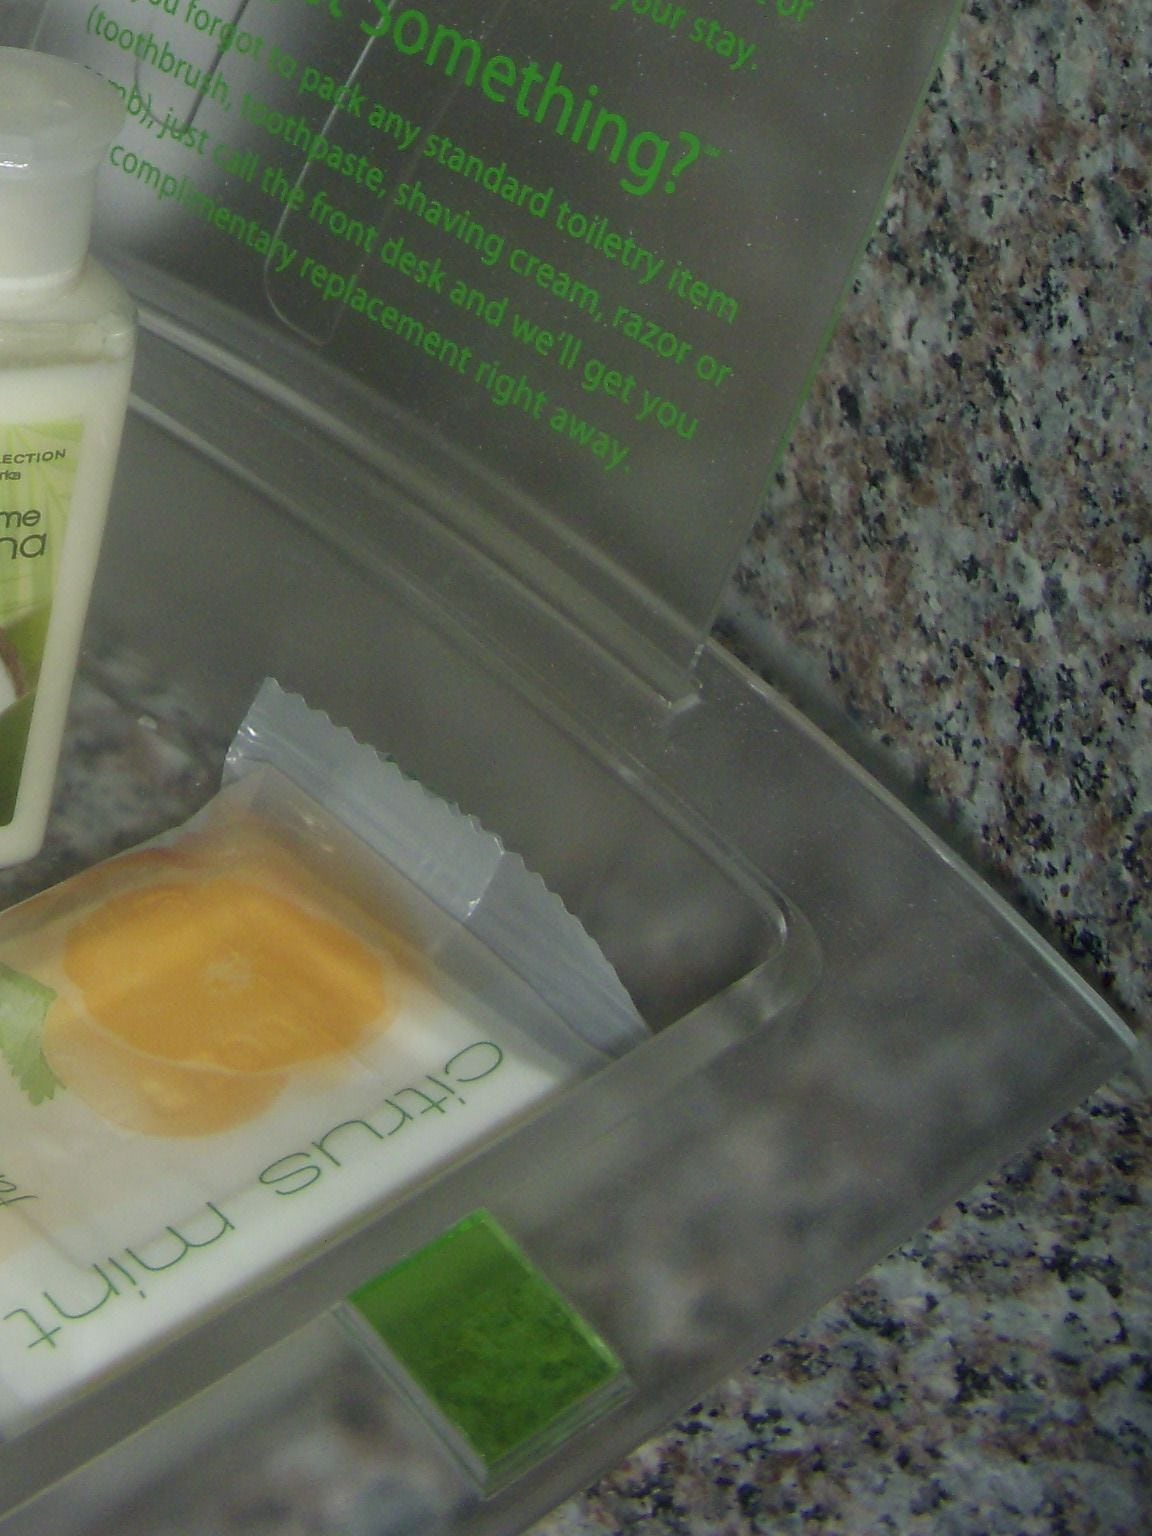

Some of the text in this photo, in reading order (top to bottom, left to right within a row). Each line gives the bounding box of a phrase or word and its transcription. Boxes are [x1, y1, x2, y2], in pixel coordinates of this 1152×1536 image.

[268, 46, 298, 80] to
[298, 66, 366, 117] pack
[368, 102, 422, 151] any
[423, 133, 554, 218] standard
[555, 201, 666, 285] toiletry
[666, 260, 739, 324] item
[689, 16, 758, 71] stay.
[87, 4, 734, 388] (toothbrush, toothpaste, shaving cream, razor or
[156, 107, 209, 155] just
[212, 142, 260, 183] call
[259, 165, 306, 211] the
[309, 190, 379, 253] front
[379, 238, 448, 293] desk
[449, 280, 509, 328] and
[511, 314, 583, 370] we'll
[581, 359, 637, 404] get
[635, 390, 699, 441] you
[299, 257, 473, 374] replacement
[472, 360, 547, 420] right
[2, 1040, 504, 1350] citrus mint
